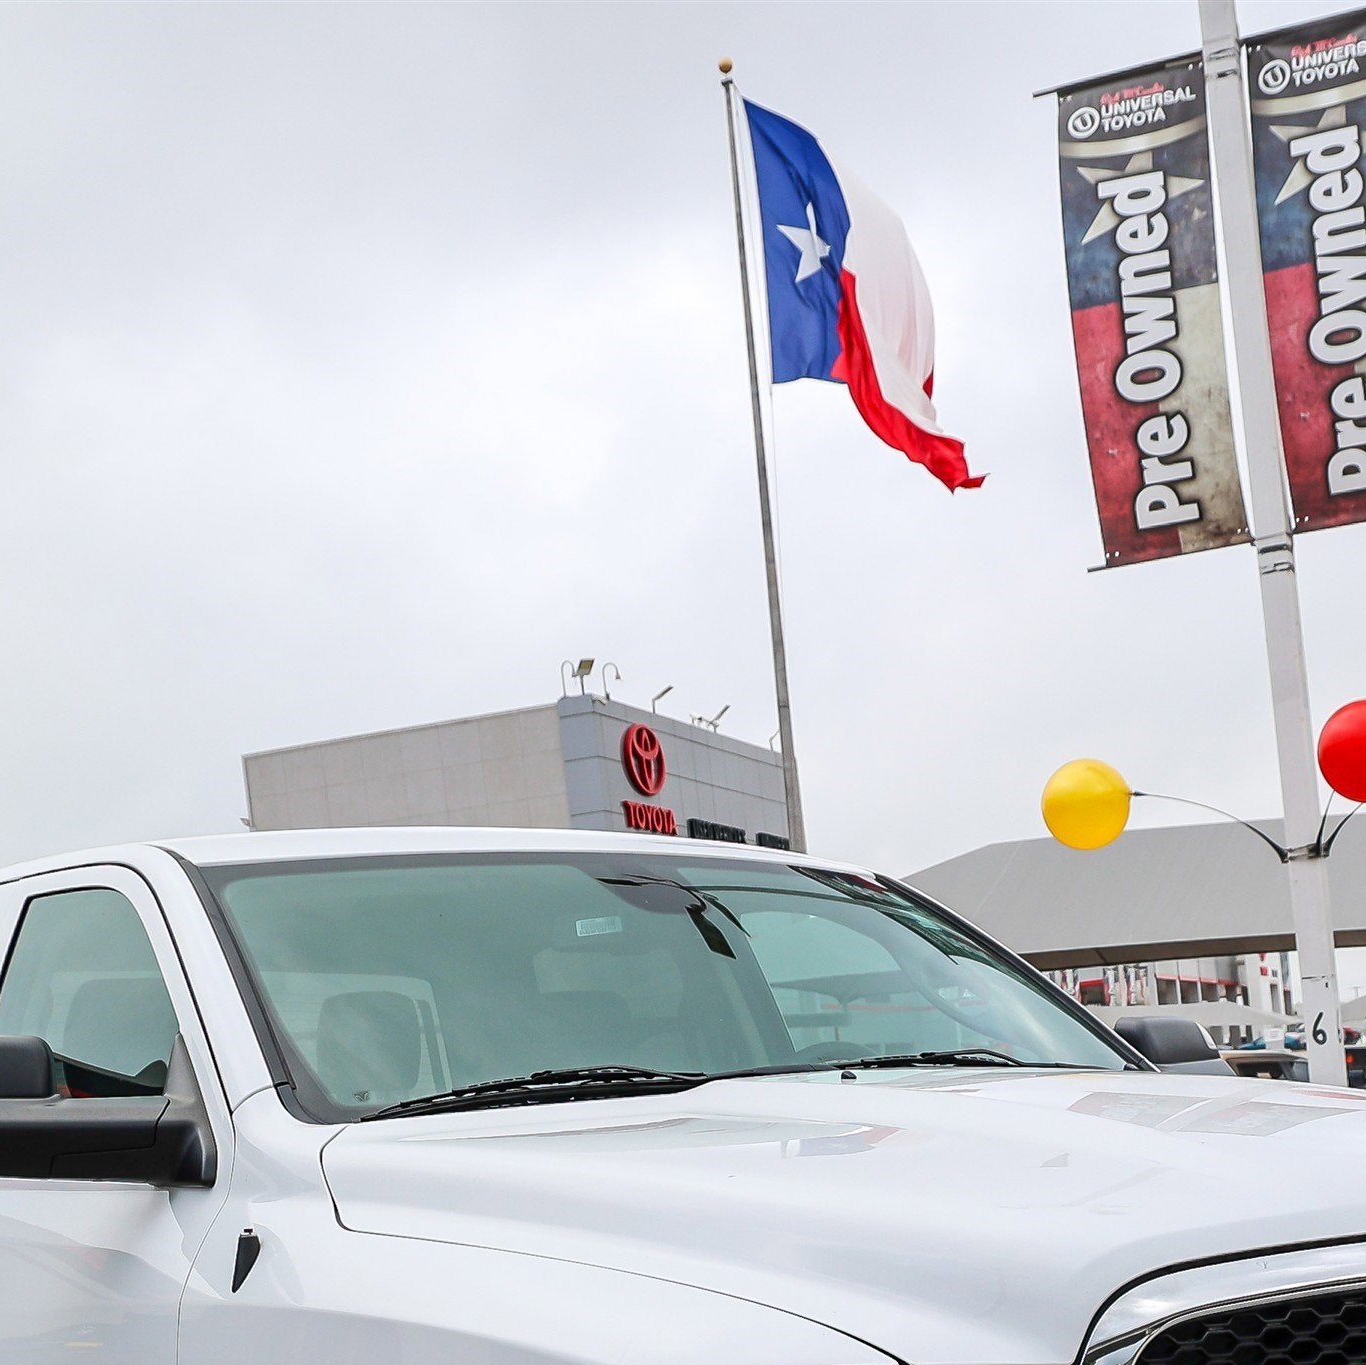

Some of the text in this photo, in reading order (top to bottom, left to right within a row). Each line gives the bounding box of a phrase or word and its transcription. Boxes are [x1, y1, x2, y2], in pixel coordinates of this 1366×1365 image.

[1292, 58, 1360, 87] TOYOTA
[1101, 86, 1197, 117] UNIVERSAL
[1102, 107, 1166, 133] TOYOTA
[1098, 170, 1182, 402] Owned
[1136, 412, 1201, 530] Pre
[621, 800, 678, 836] TOYOTA
[1312, 1011, 1327, 1045] 6
